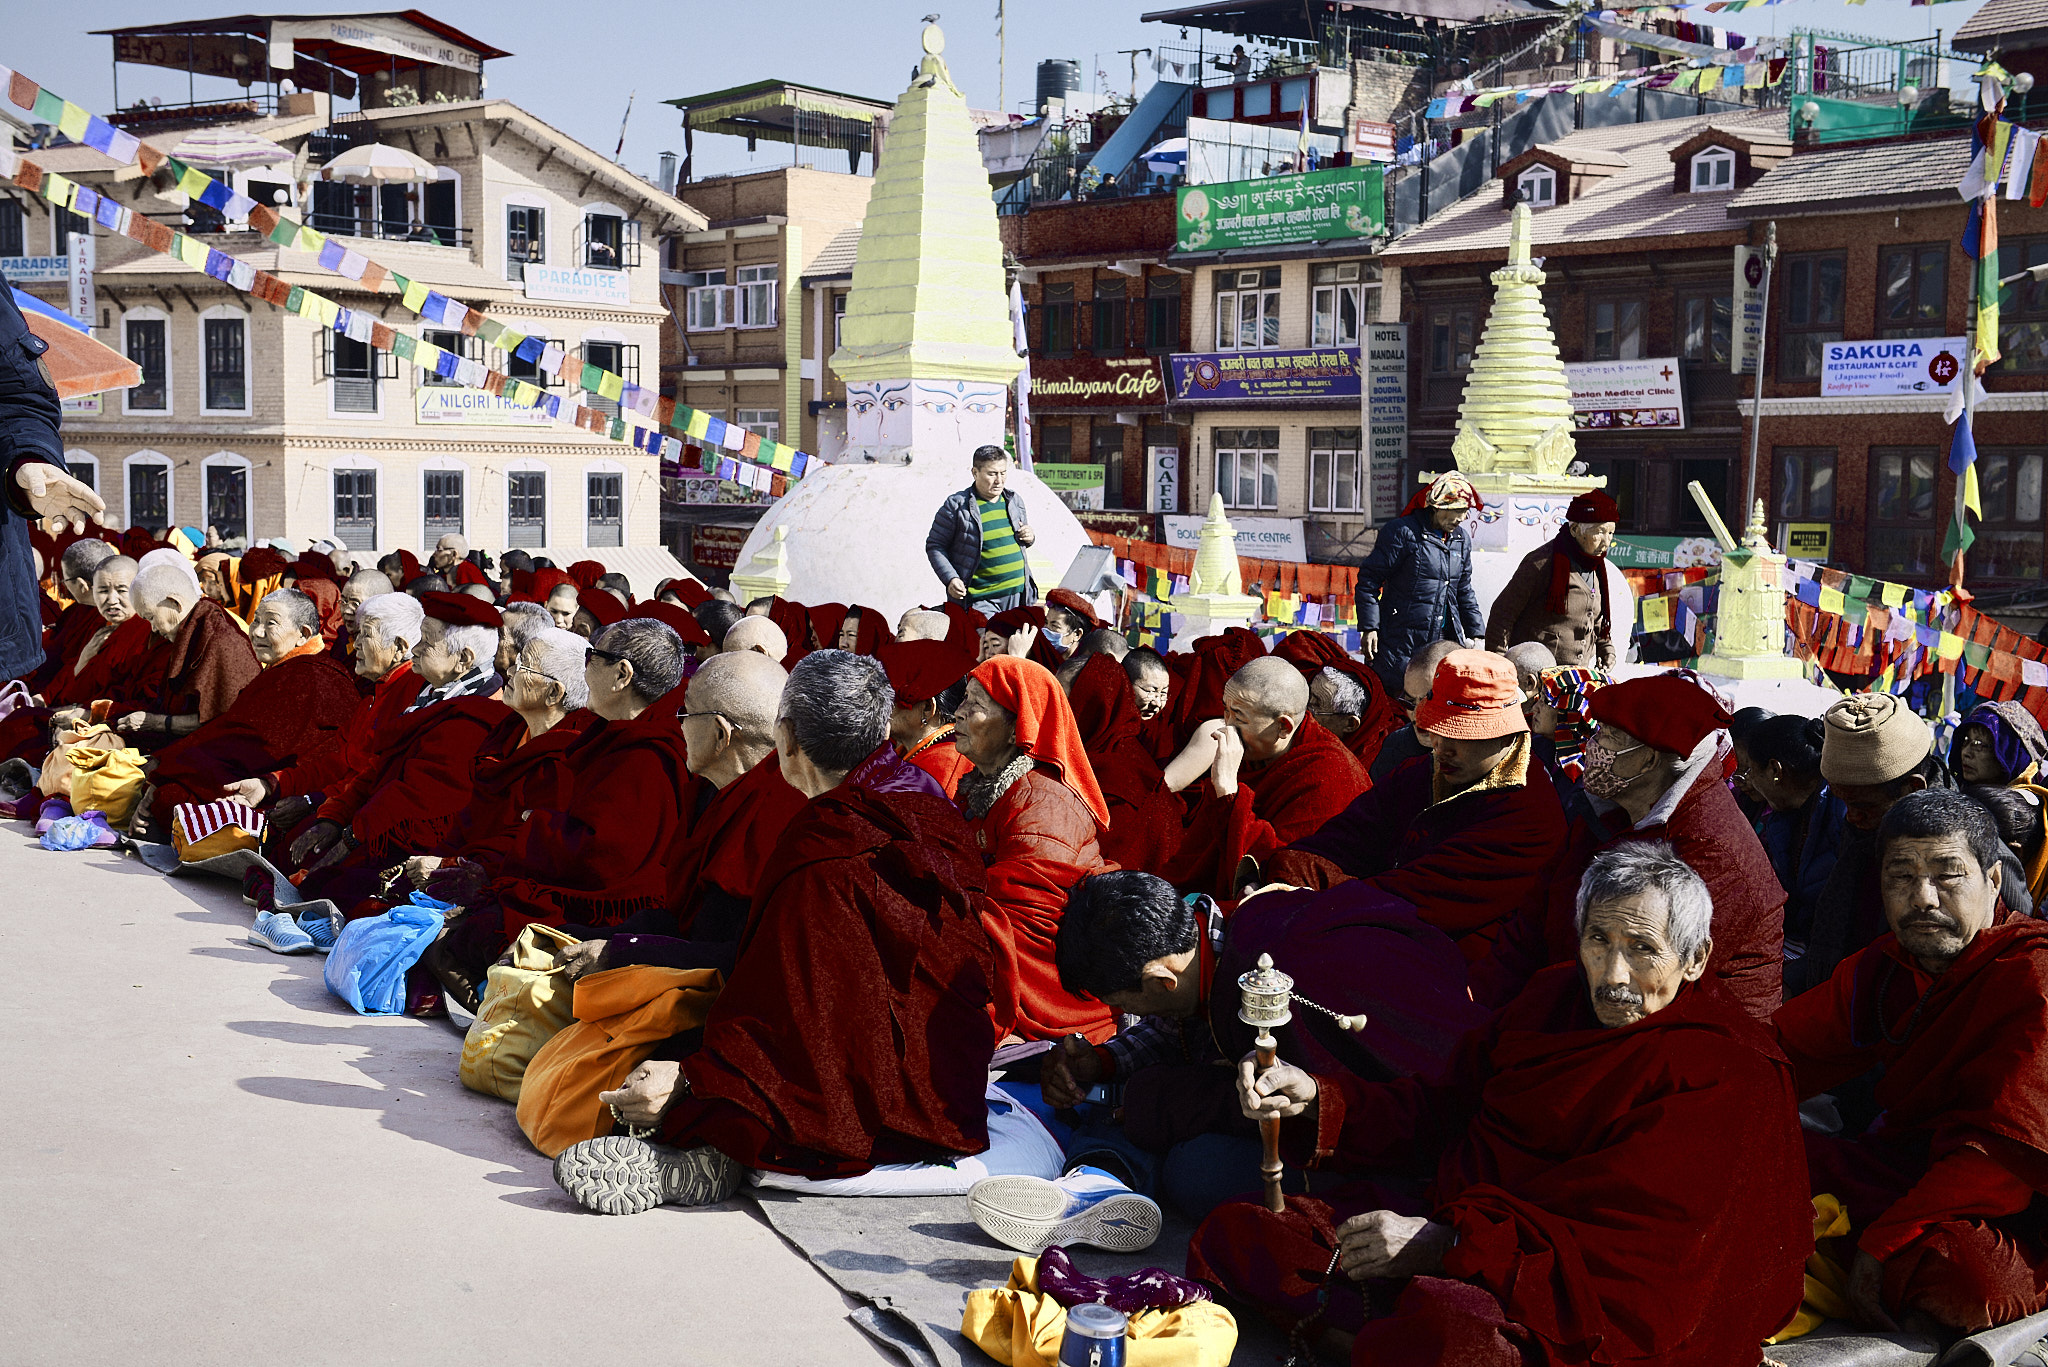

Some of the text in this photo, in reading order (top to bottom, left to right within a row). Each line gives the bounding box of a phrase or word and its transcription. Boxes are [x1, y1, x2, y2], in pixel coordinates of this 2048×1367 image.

[438, 50, 454, 62] AND
[458, 52, 479, 68] CAFE
[1, 258, 68, 269] PARADISE
[539, 270, 616, 288] PARADISE
[529, 284, 589, 295] RESTAURANT
[606, 291, 627, 299] CAFE
[1375, 331, 1401, 341] HOTEL
[1370, 350, 1405, 360] MANDALA
[1830, 343, 1923, 361] SAKURA
[1827, 362, 1886, 371] RESTAURANT
[1895, 361, 1918, 369] CAFE
[1376, 376, 1399, 384] HOTEL
[1834, 371, 1904, 382] (Japanese Food)
[1031, 369, 1161, 399] Himalayan Cafe
[1827, 383, 1853, 392] Rooftop
[1571, 387, 1675, 399] ibetan Medical Clinic
[440, 394, 490, 408] NILGIRI
[1369, 396, 1406, 404] CHHORTEN
[1373, 406, 1403, 414] PVT. LTD.
[1372, 425, 1405, 434] KHASYOR
[1375, 438, 1402, 447] GUEST
[1375, 450, 1402, 459] HOUSE
[1036, 469, 1056, 479] BEAUTY
[1057, 469, 1087, 480] TREATMENT
[1093, 471, 1103, 480] SPA
[1158, 456, 1174, 510] CAFE
[1259, 532, 1291, 543] CENTRE
